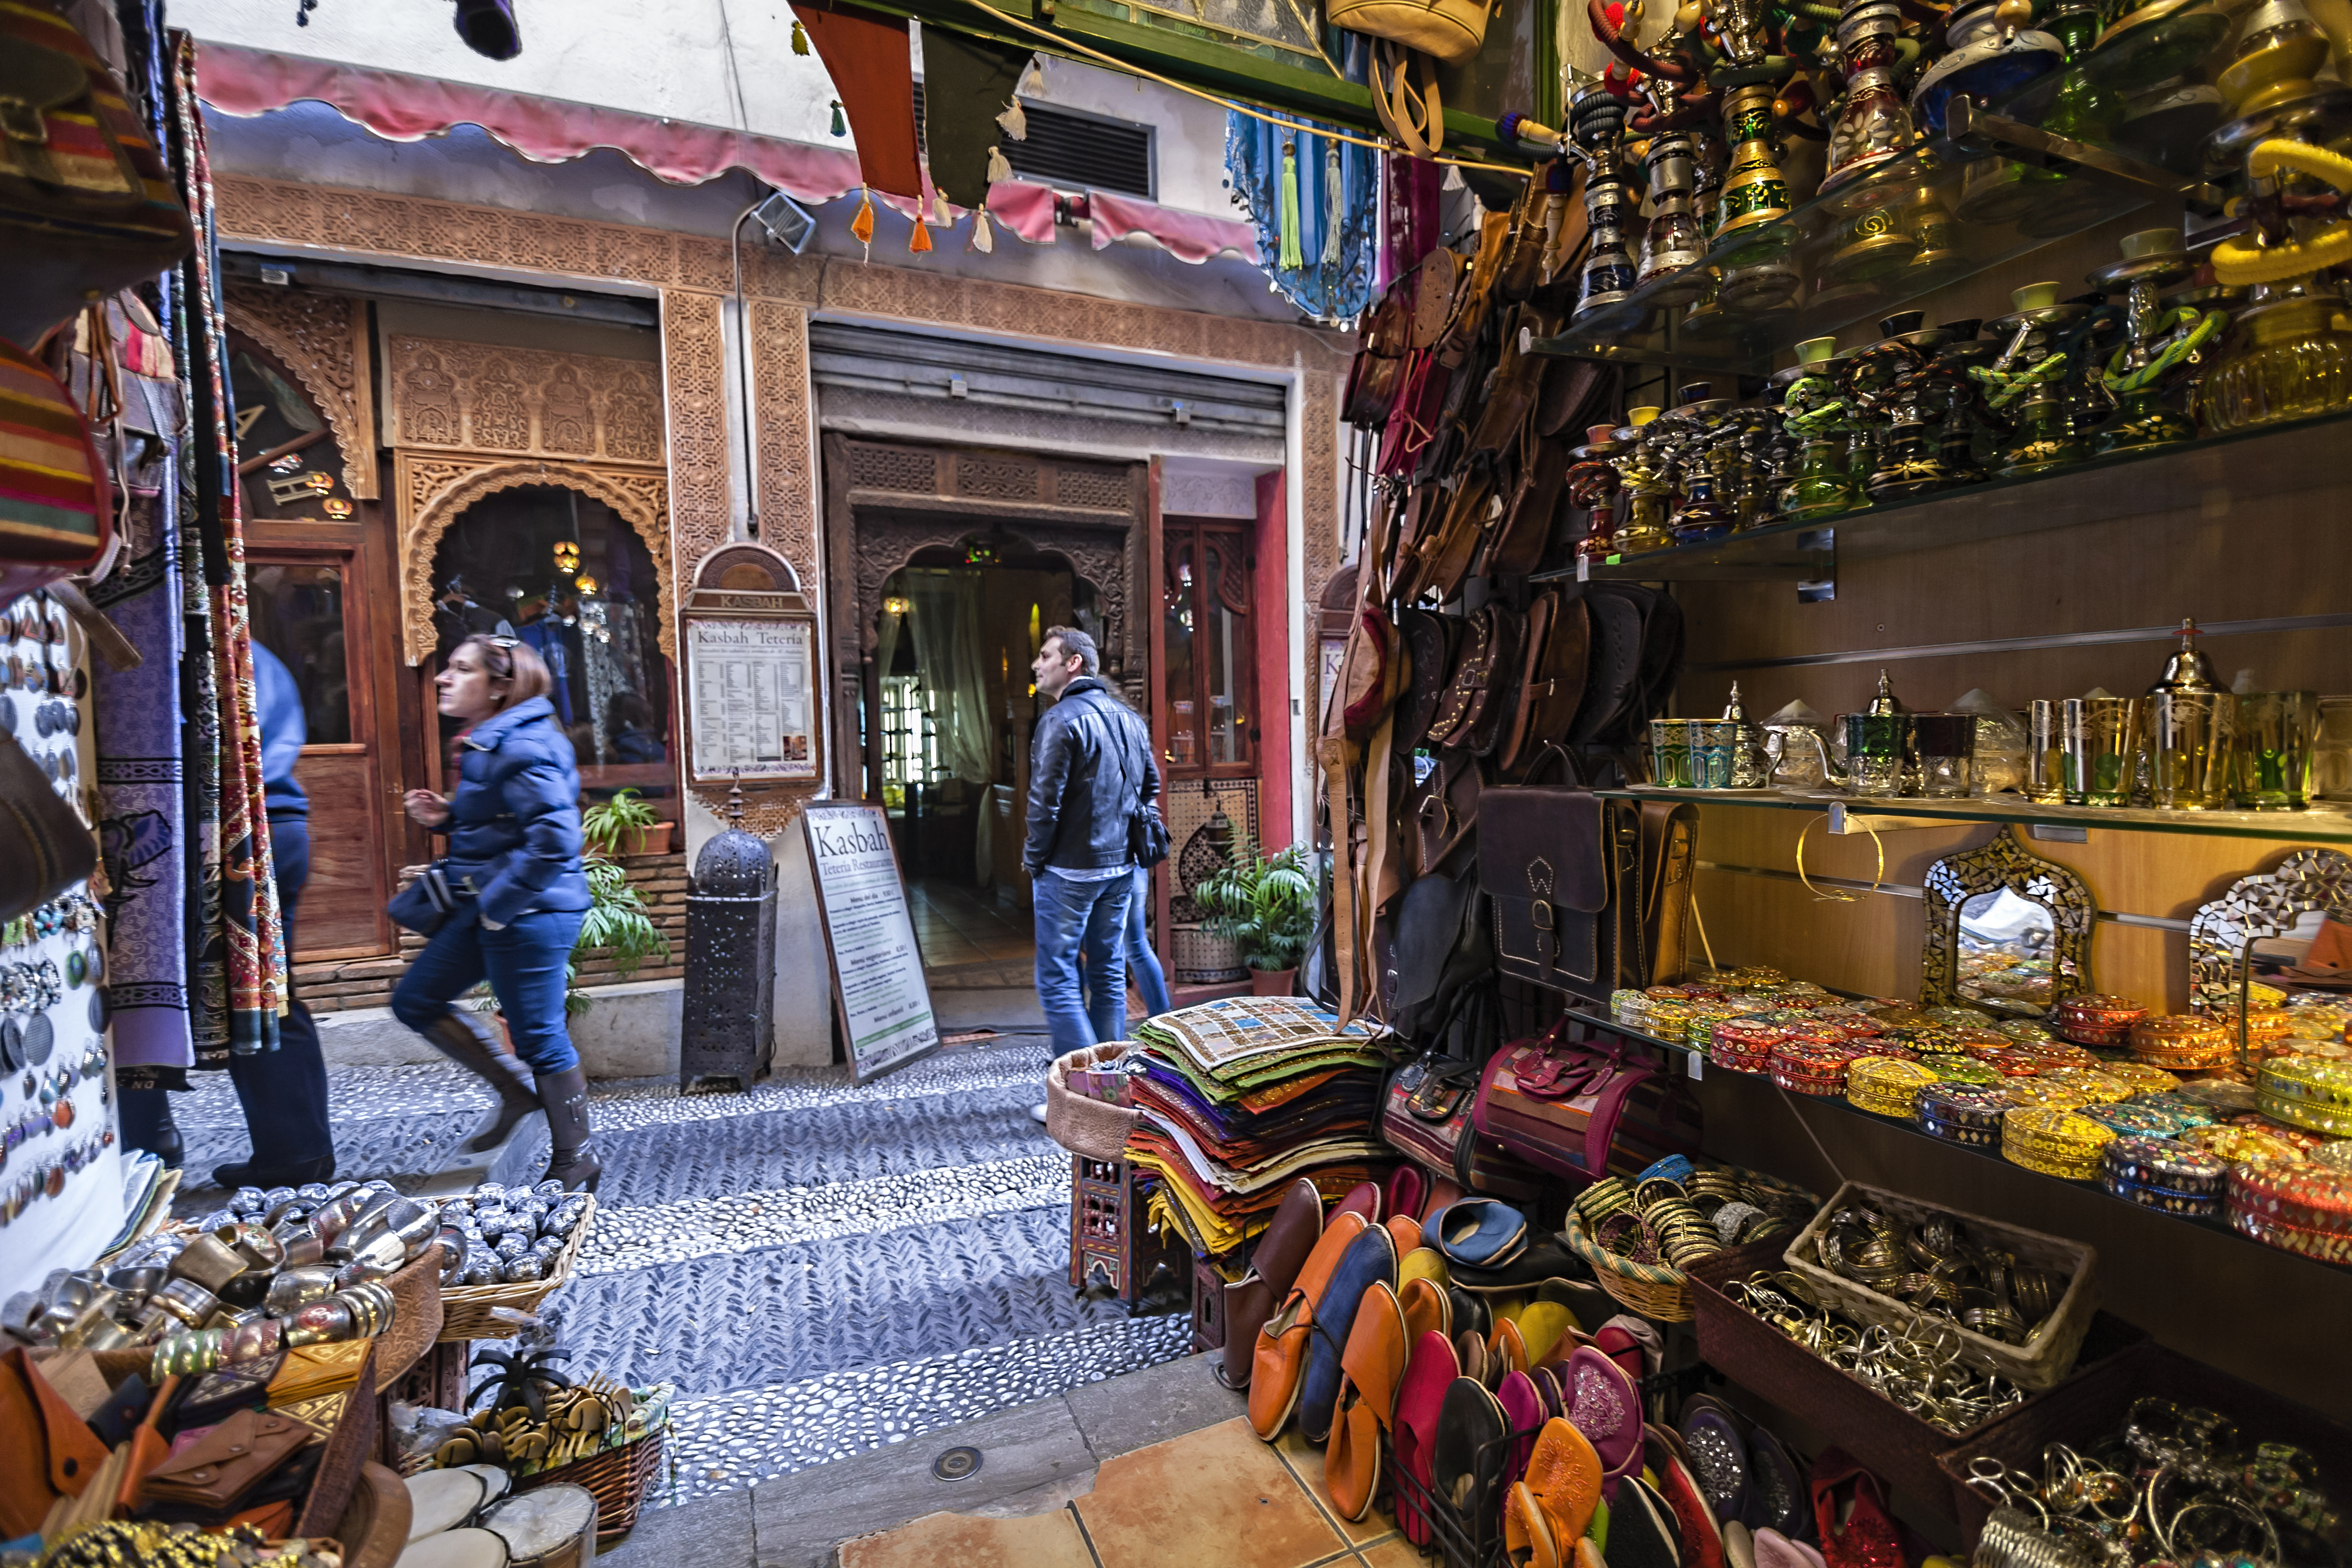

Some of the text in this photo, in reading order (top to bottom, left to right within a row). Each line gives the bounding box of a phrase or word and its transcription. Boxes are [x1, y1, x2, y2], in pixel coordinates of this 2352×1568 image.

[720, 595, 783, 608] KASBAH
[698, 631, 748, 644] Kasbah
[814, 821, 890, 857] Kasbah
